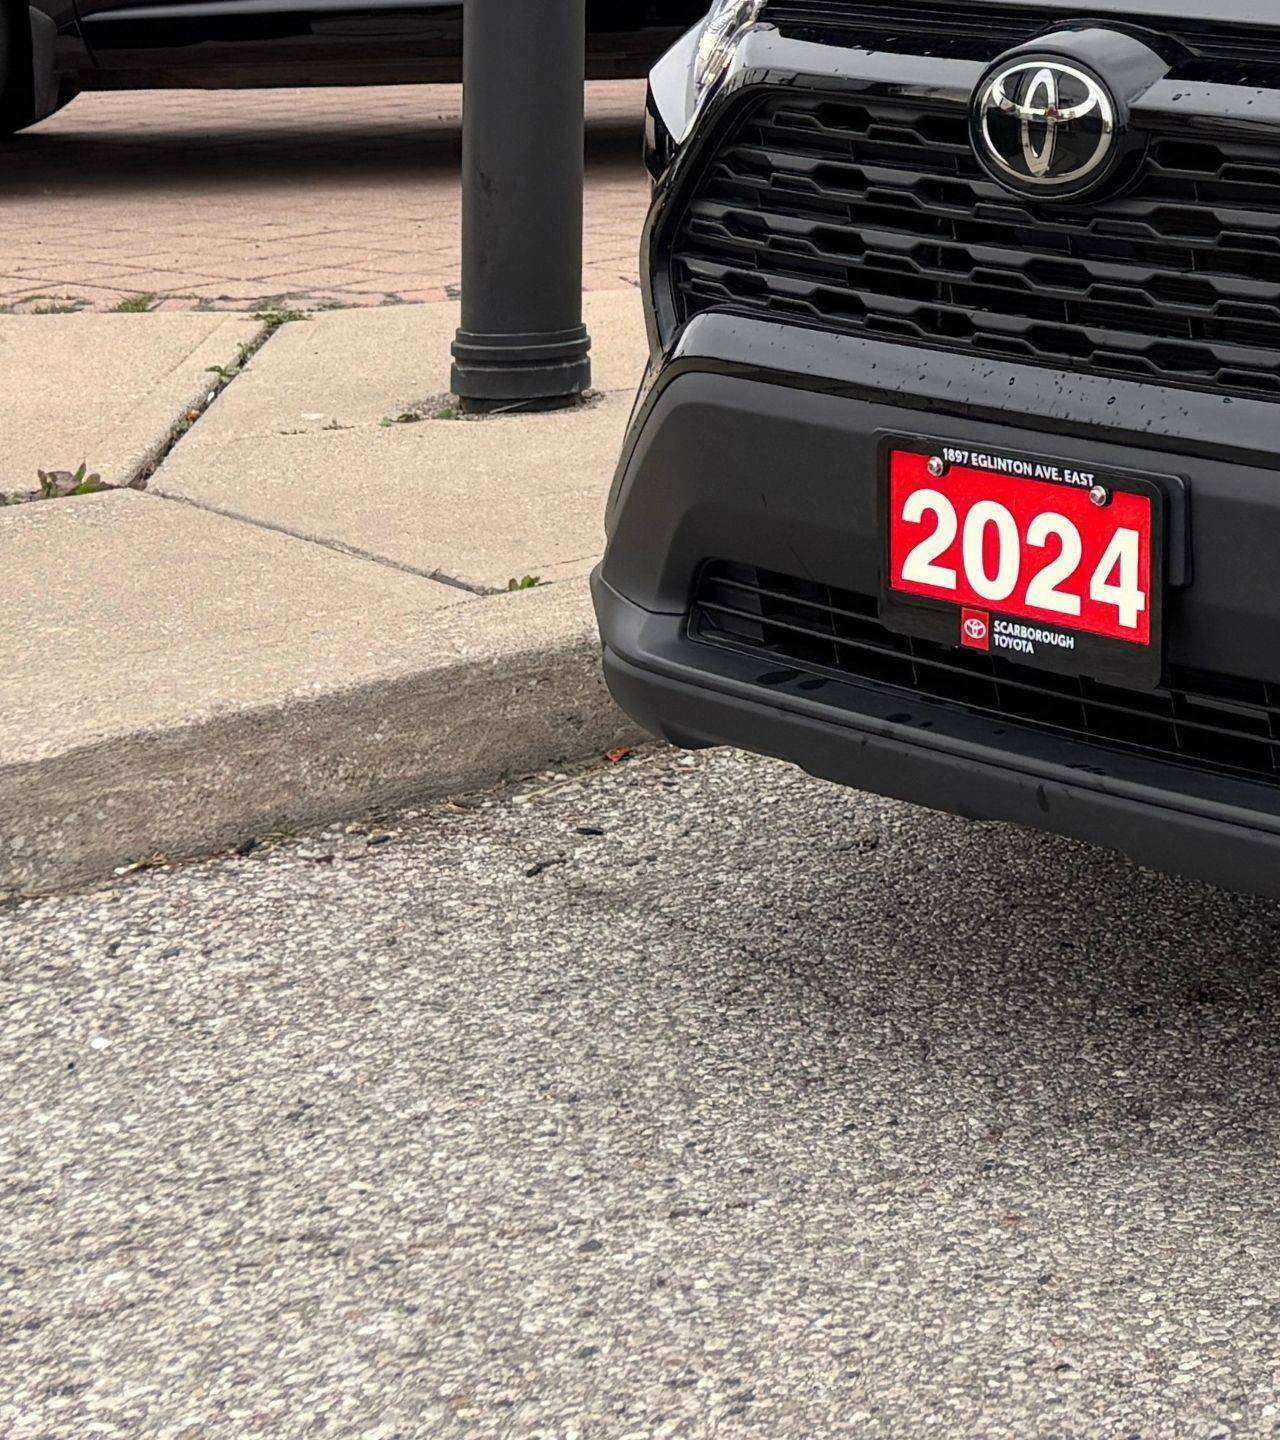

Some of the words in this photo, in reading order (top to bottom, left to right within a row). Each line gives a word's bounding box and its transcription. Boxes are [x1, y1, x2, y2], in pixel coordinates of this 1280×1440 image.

[942, 447, 969, 464] 1897
[971, 453, 1033, 476] EGLINTON
[1035, 464, 1063, 482] AVE.
[1064, 469, 1095, 487] EAST
[901, 488, 1146, 629] 2024
[993, 620, 1075, 649] SCARBOROUGH
[993, 633, 1035, 654] TOYOTA
